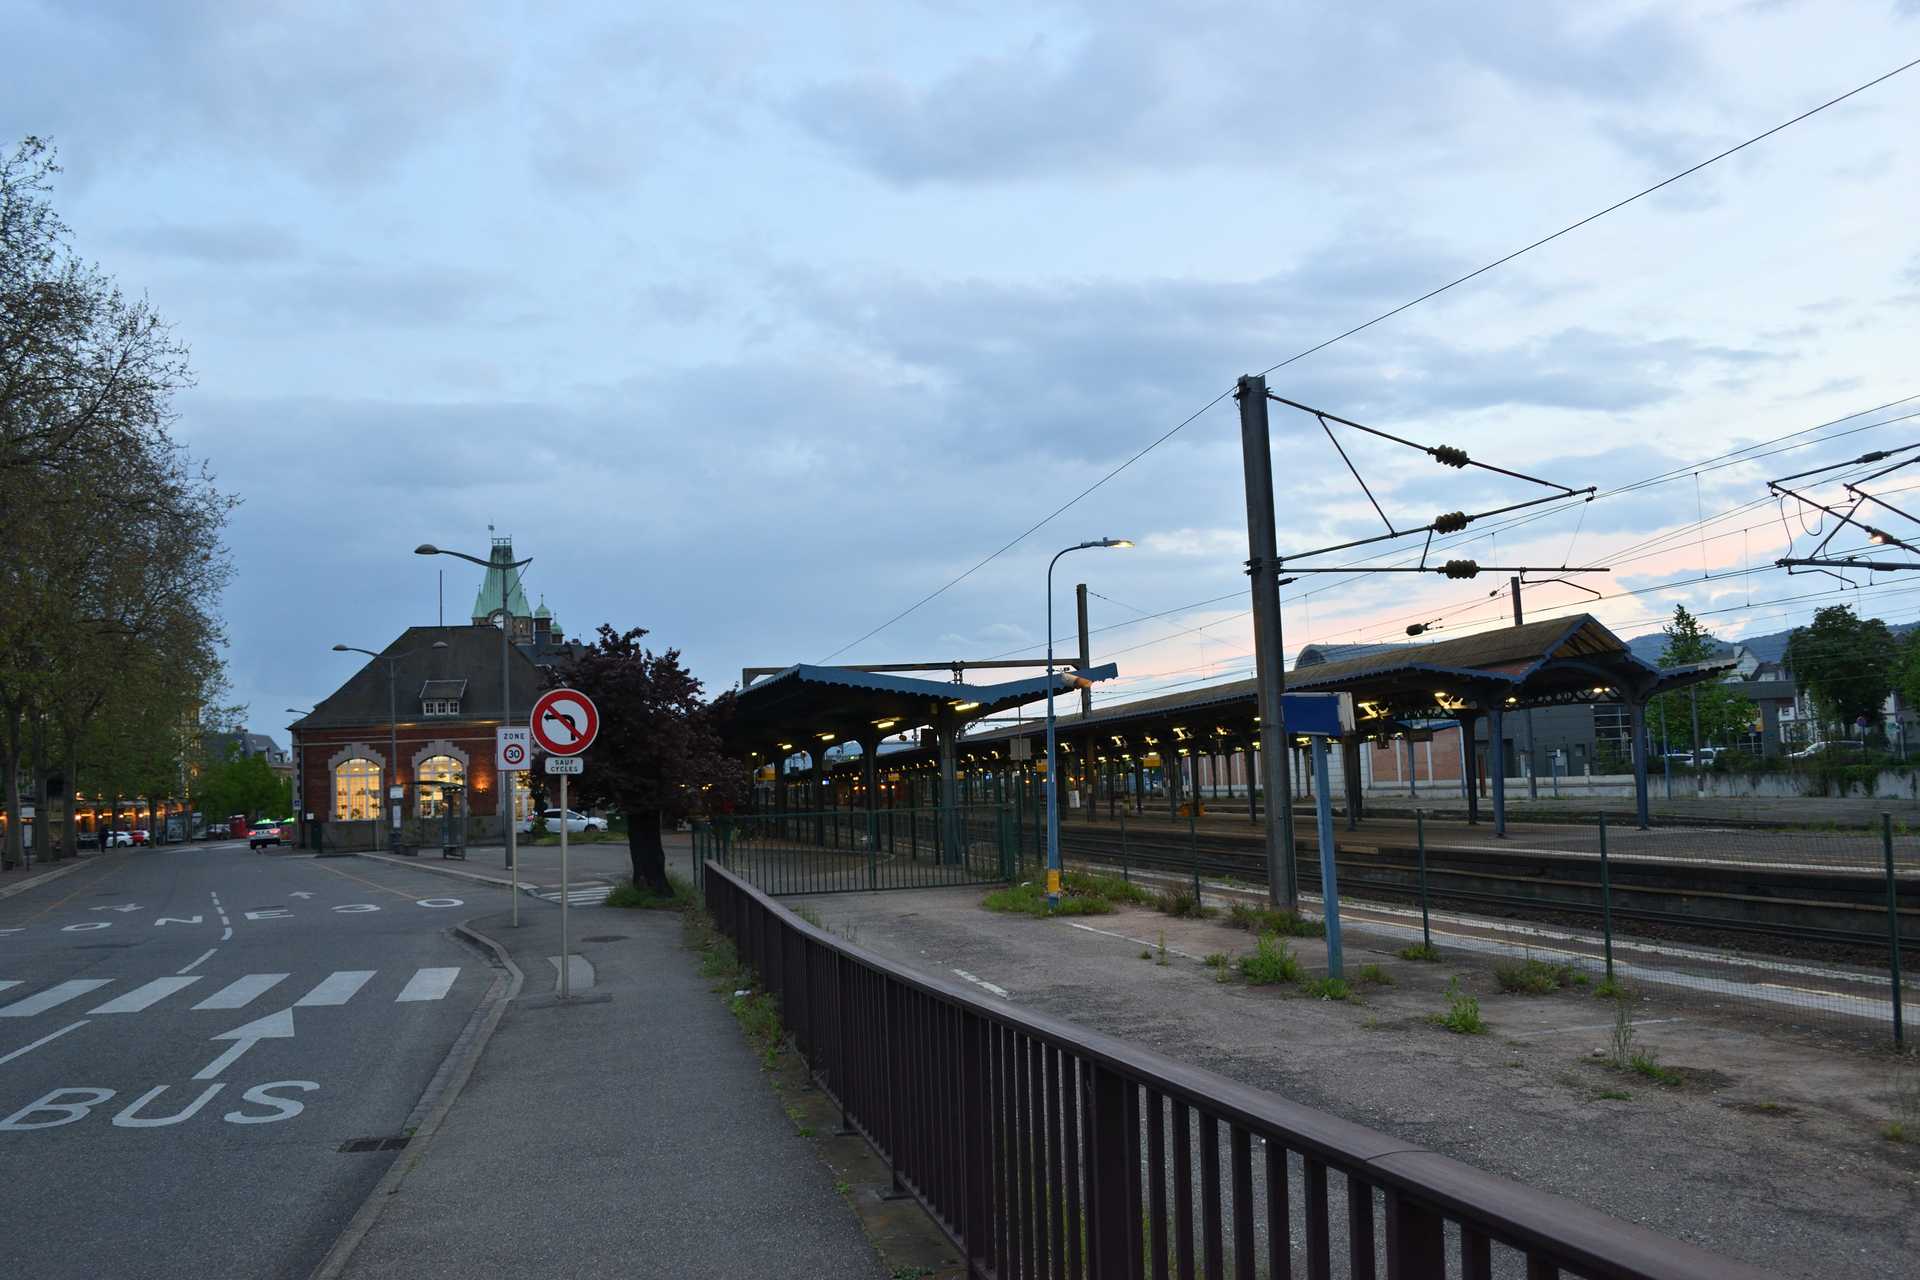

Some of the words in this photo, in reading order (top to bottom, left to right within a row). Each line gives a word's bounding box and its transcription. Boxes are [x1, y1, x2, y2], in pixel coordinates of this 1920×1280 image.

[508, 749, 520, 759] 30
[331, 898, 465, 913] 30
[0, 1079, 321, 1131] BUS
